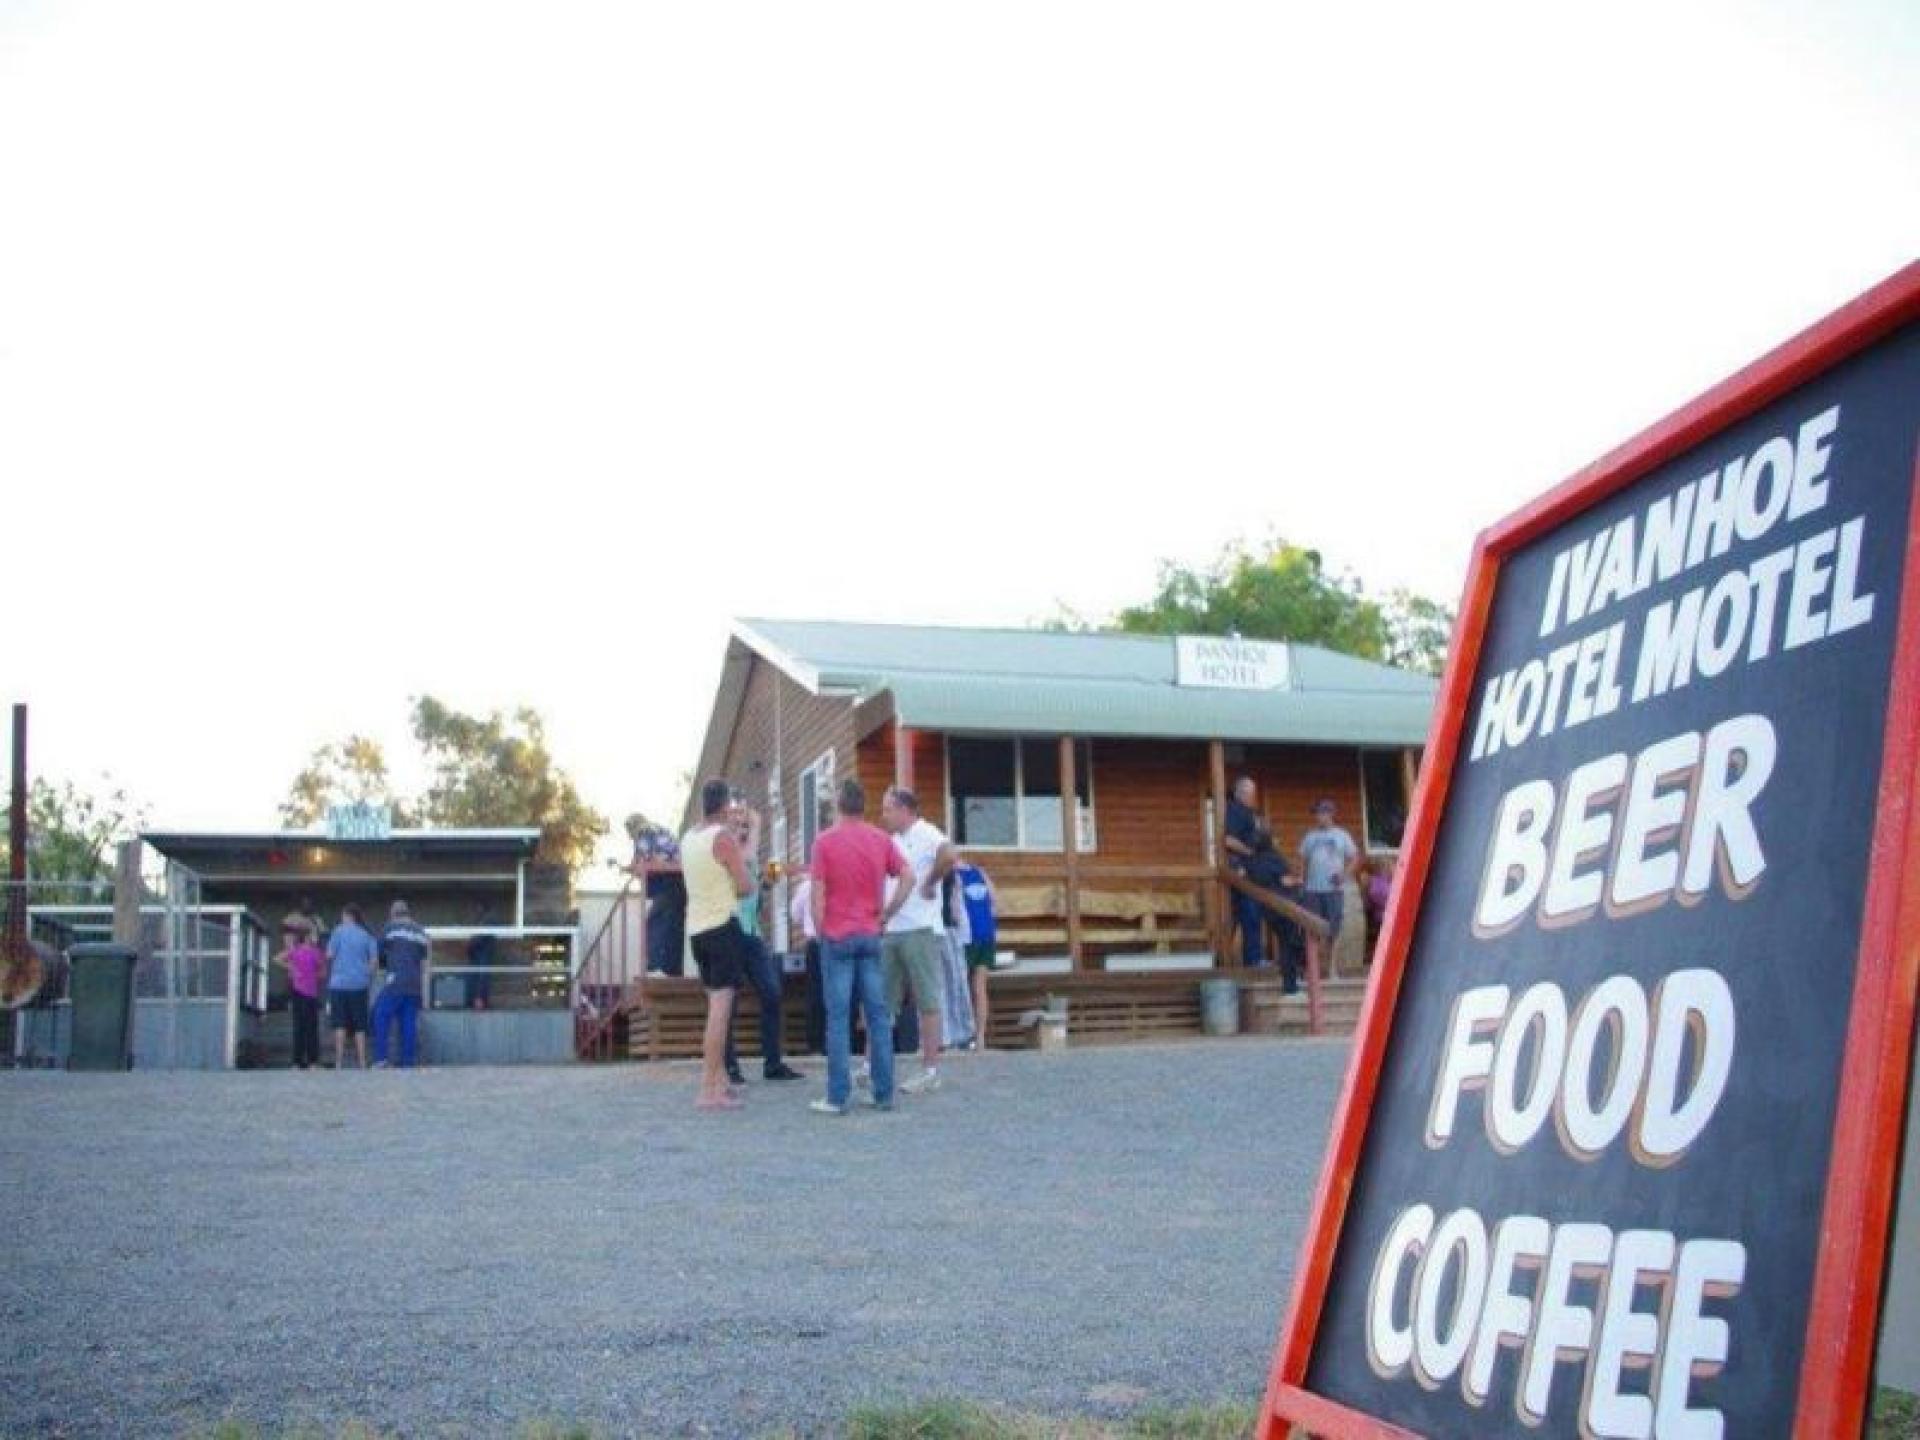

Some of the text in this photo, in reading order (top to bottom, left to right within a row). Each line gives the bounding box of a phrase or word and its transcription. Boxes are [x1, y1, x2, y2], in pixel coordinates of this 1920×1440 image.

[1539, 405, 1840, 636] IVANHOE
[1470, 515, 1876, 762] HOTEL MOTEL
[1473, 714, 1777, 938] BEER
[1425, 968, 1736, 1168] FOOD
[1367, 1203, 1747, 1440] COFFEE
